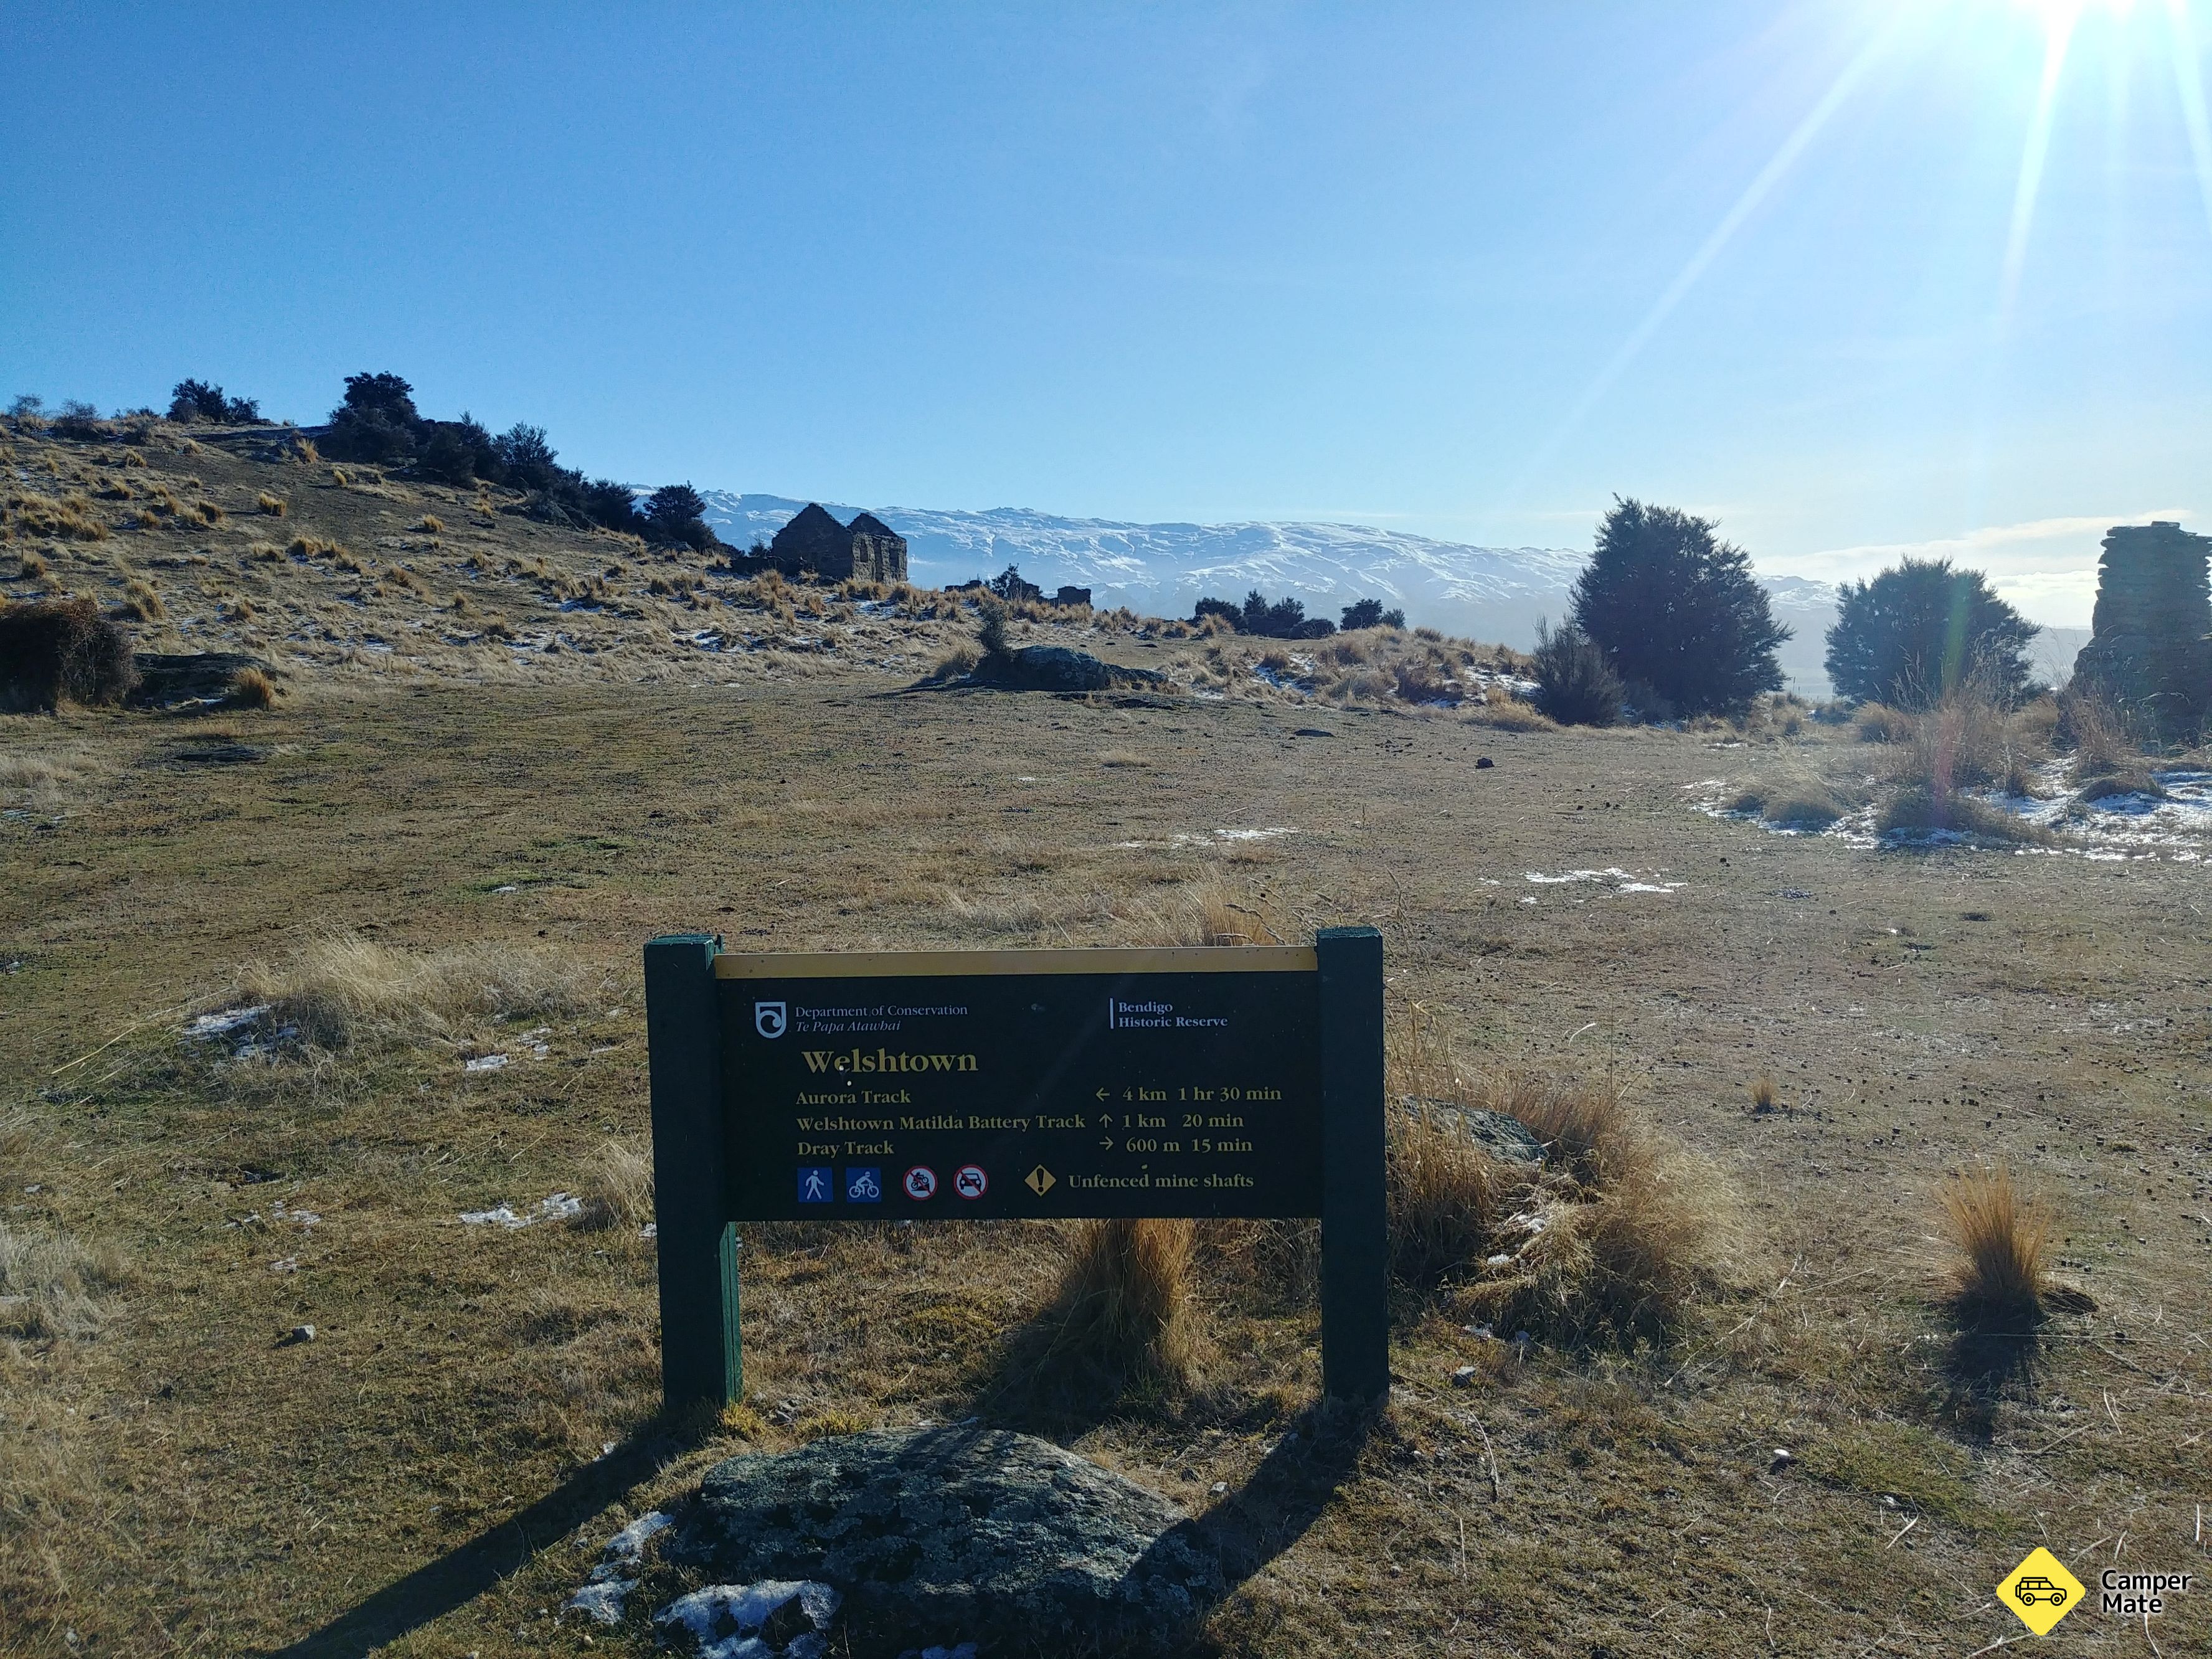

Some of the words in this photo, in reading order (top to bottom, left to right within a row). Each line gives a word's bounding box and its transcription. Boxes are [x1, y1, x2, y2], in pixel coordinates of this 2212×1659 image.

[795, 1006, 868, 1019] Department
[872, 1005, 884, 1016] of
[887, 1004, 968, 1016] Conservation
[1118, 1001, 1173, 1013] Bendigo
[796, 1021, 810, 1033] Te
[813, 1021, 844, 1034] Papa
[848, 1020, 902, 1032] Atawhai
[1118, 1016, 1172, 1028] Historic
[1175, 1016, 1228, 1028] Reserve
[801, 1047, 979, 1074] Welshtown
[796, 1092, 857, 1105] Aurora
[861, 1089, 912, 1104] Track
[1122, 1087, 1133, 1100] 4
[1138, 1087, 1167, 1101] km
[1178, 1088, 1186, 1100] 1
[1193, 1087, 1214, 1100] hr
[1220, 1087, 1240, 1101] 30
[1245, 1087, 1282, 1100] min
[796, 1117, 895, 1131] Welshtown
[899, 1115, 963, 1130] Matilda
[968, 1115, 1031, 1132] Battery
[1036, 1114, 1086, 1129] Track
[1122, 1115, 1130, 1128] 1
[1138, 1114, 1166, 1128] km
[1182, 1114, 1203, 1127] 20
[1208, 1114, 1244, 1127] min
[797, 1142, 841, 1158] Dray
[844, 1140, 895, 1155] Track
[1126, 1137, 1157, 1152] 600
[1163, 1141, 1181, 1152] m
[1191, 1138, 1211, 1152] 15
[1217, 1138, 1254, 1152] min
[1069, 1174, 1150, 1188] Unfenced
[1155, 1175, 1199, 1188] mine
[1204, 1174, 1254, 1188] shafts
